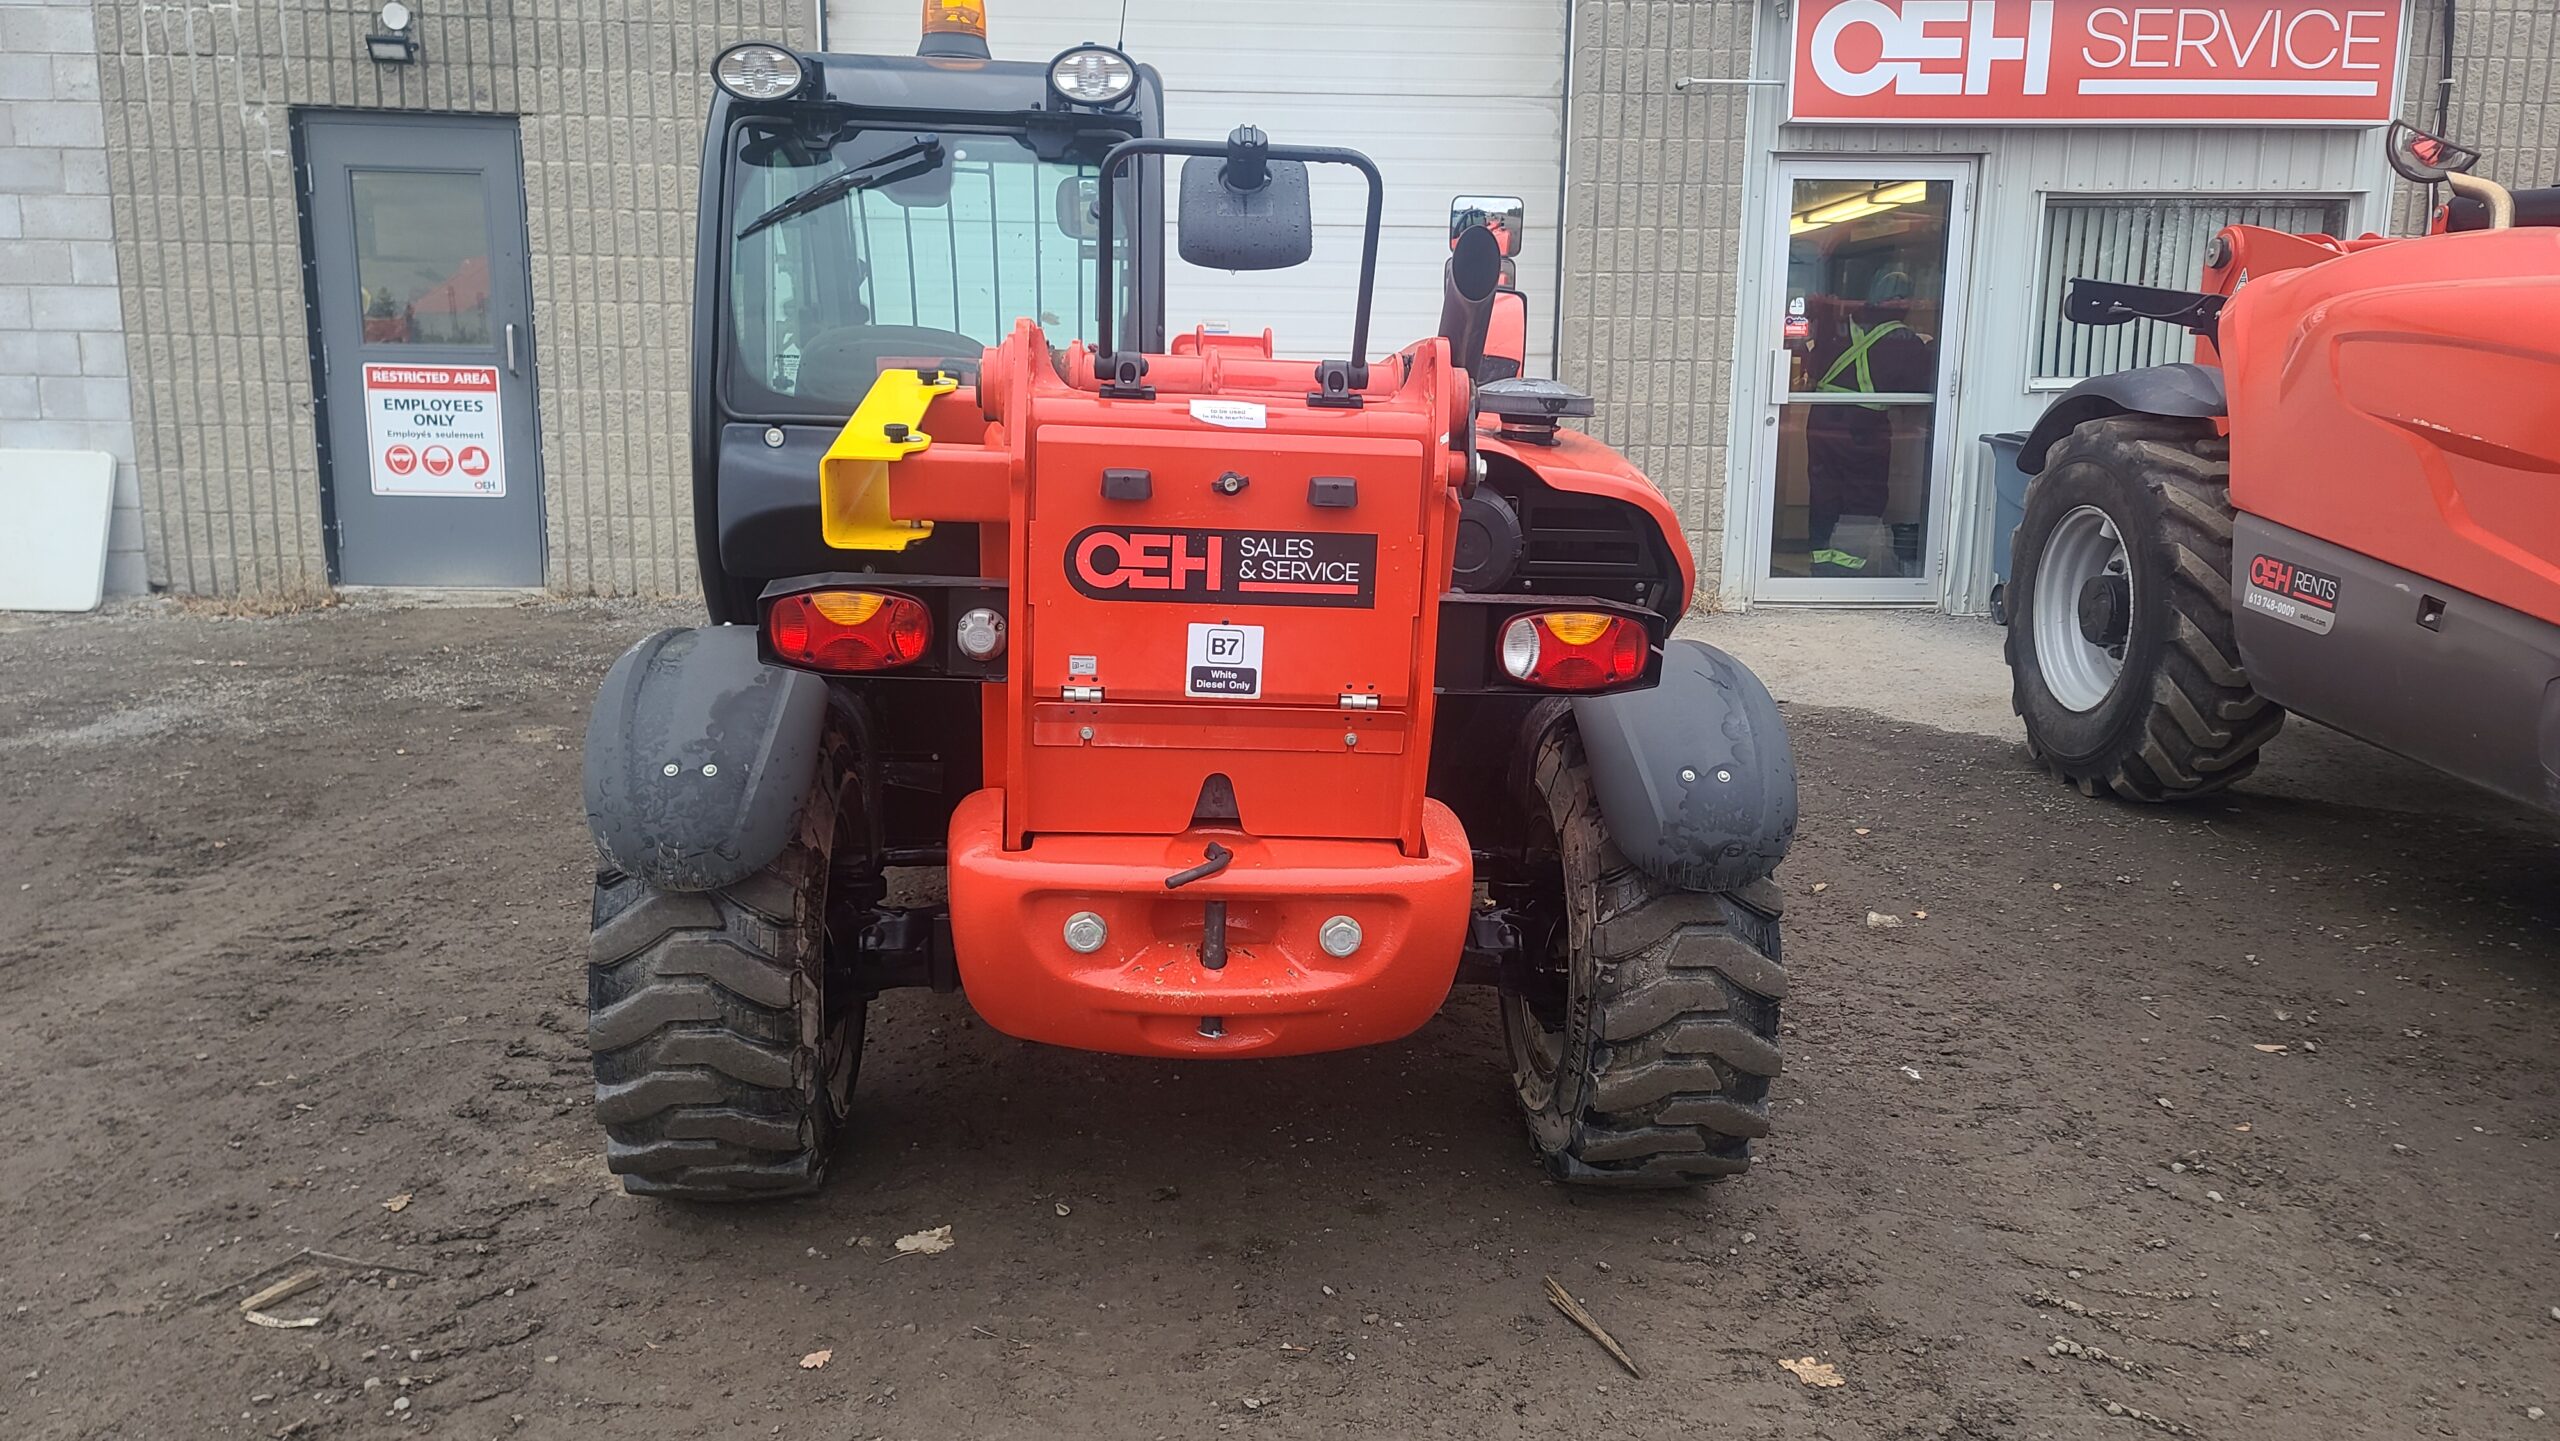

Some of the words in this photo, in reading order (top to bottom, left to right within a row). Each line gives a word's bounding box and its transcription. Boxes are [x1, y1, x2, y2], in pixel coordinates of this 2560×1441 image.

[1811, 0, 2054, 96] OEH
[2082, 8, 2386, 69] SERVICE
[372, 369, 449, 384] RESTRICTED
[454, 371, 490, 385] AREA
[384, 398, 484, 413] EMPLOYEES
[413, 414, 456, 427] ONLY
[387, 430, 432, 440] Employés
[435, 431, 485, 440] seulement
[474, 481, 496, 490] OEH
[1239, 537, 1314, 559] SALES
[1076, 531, 1223, 591] OEH
[1239, 560, 1257, 580] &
[1260, 560, 1360, 582] SERVICE
[2251, 556, 2293, 594] OEH
[2294, 571, 2338, 600] RENTS
[1211, 637, 1240, 656] B7
[1210, 670, 1238, 679] White
[1196, 679, 1226, 689] Diesel
[1228, 680, 1251, 691] Only
